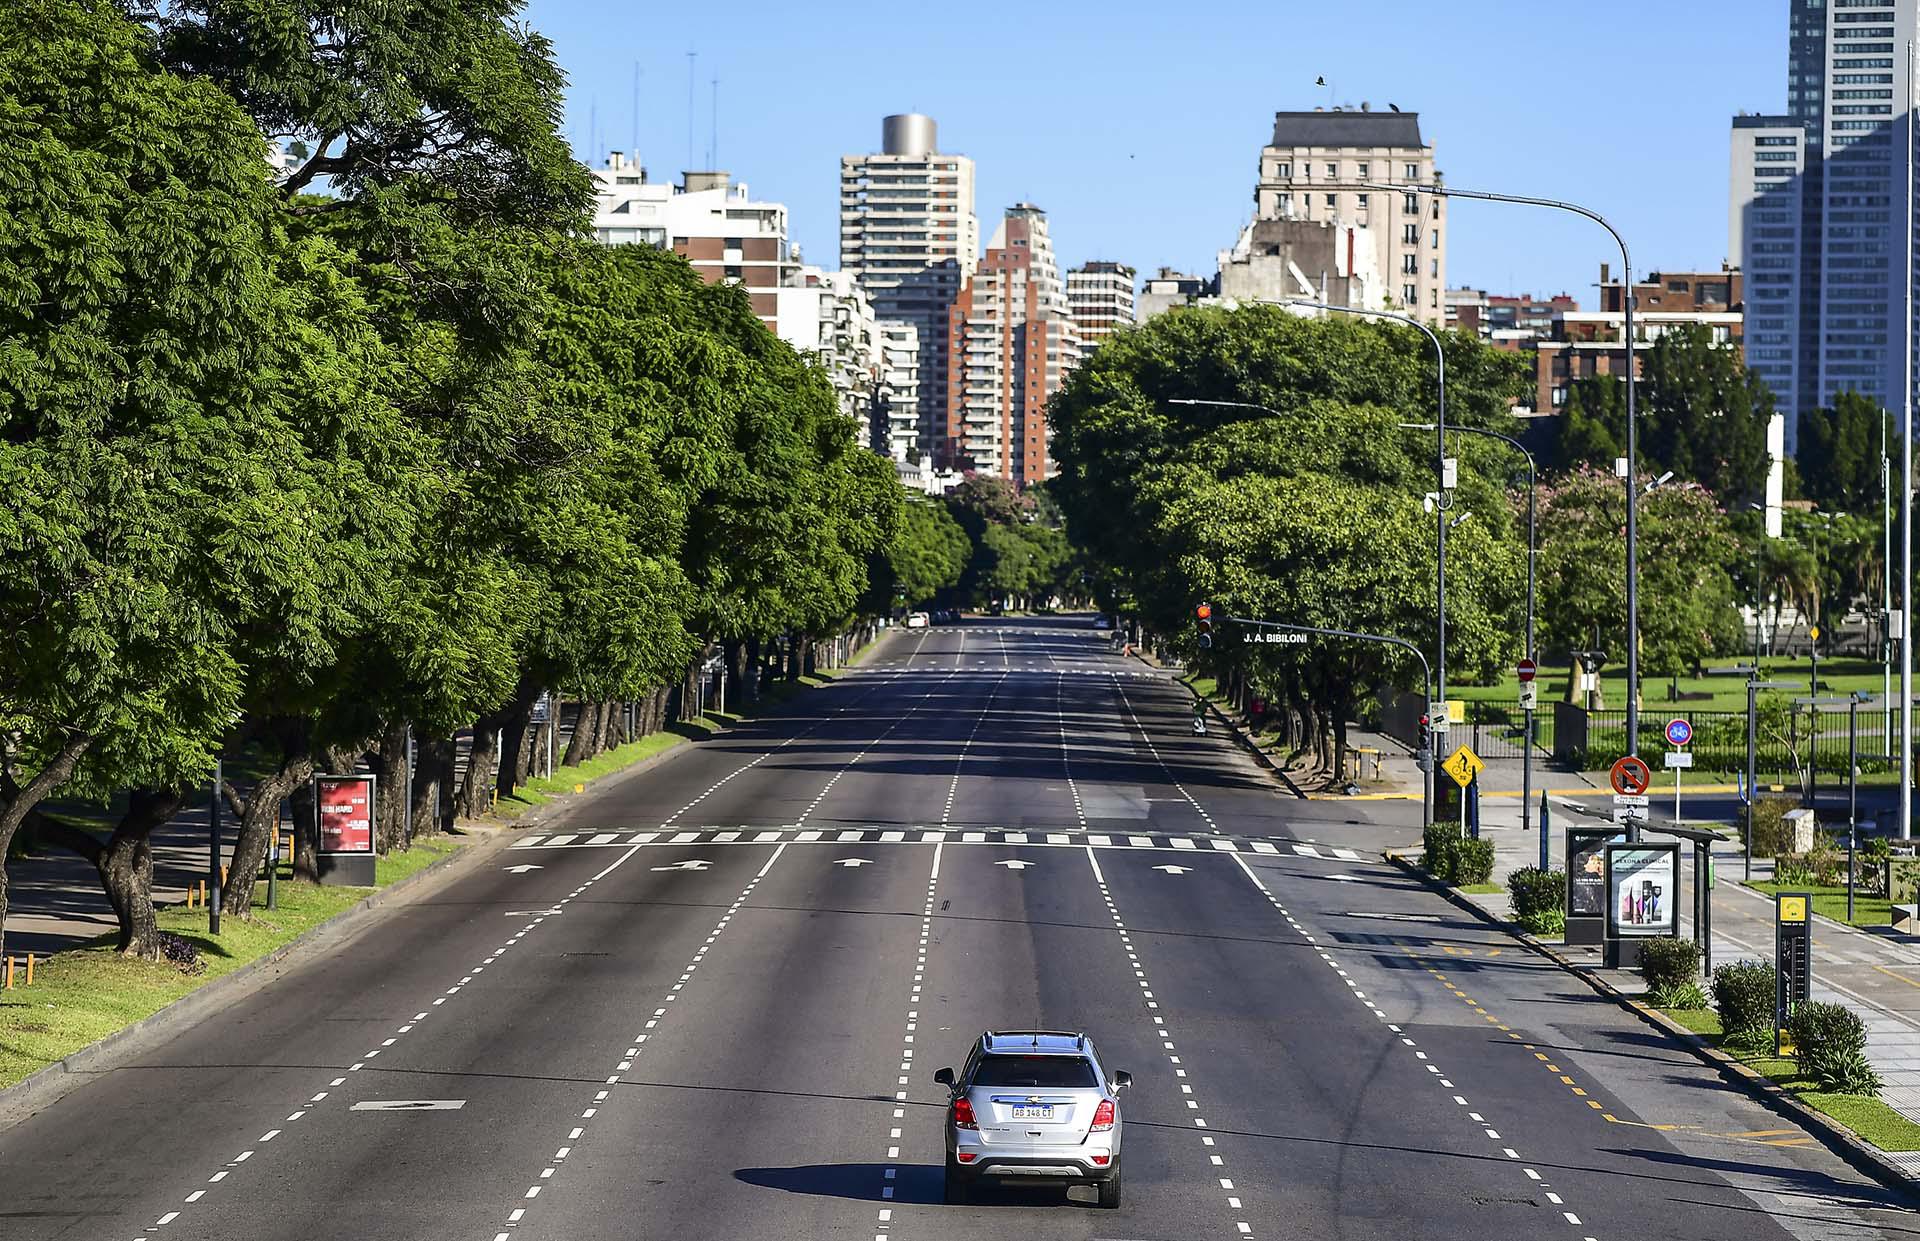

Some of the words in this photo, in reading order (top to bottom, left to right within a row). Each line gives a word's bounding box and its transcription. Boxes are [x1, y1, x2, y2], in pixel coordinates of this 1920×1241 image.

[1243, 633, 1253, 643] J.
[1254, 633, 1265, 643] A.
[1266, 633, 1308, 643] BIBILONI
